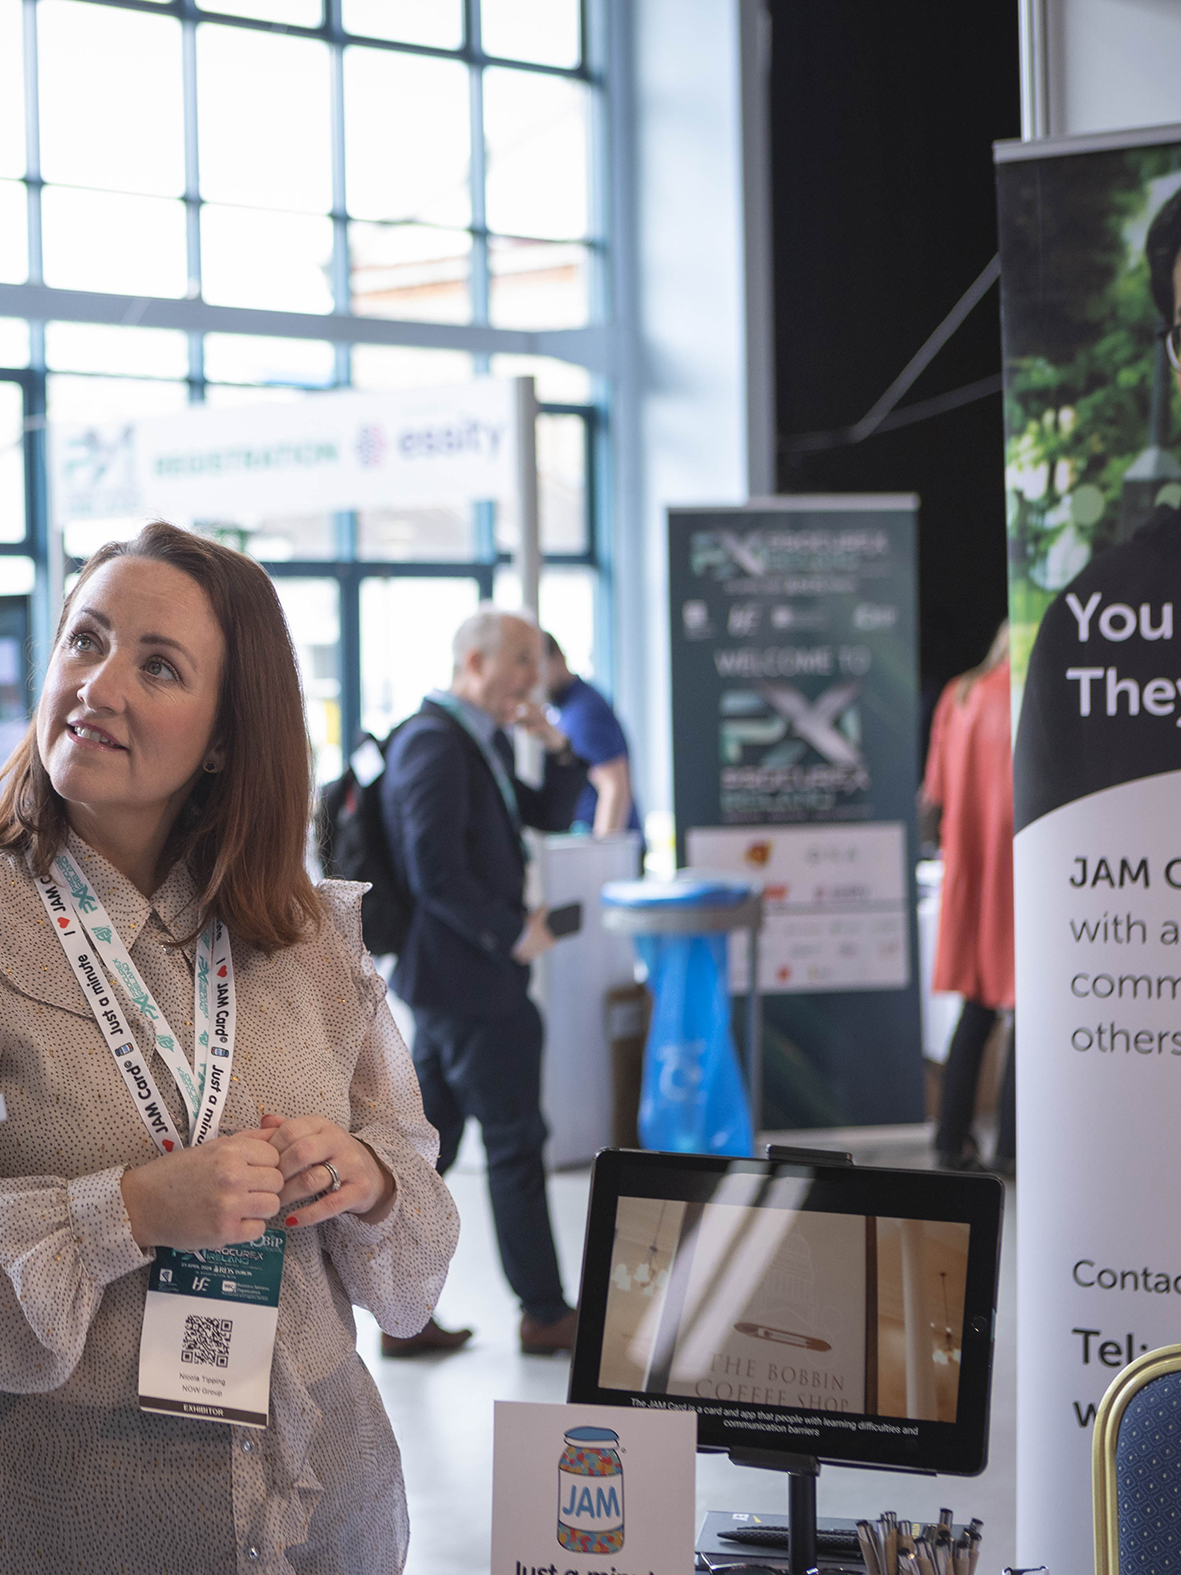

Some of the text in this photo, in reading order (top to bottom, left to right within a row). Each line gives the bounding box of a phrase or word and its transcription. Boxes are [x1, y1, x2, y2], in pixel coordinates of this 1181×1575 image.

[397, 415, 504, 461] essity
[1065, 591, 1173, 642] You
[715, 645, 833, 677] WELCOME
[1065, 665, 1181, 729] The
[1069, 856, 1150, 890] JAM
[45, 886, 66, 912] JAM
[1069, 910, 1147, 944] with
[78, 954, 123, 1035] Just a minute
[217, 983, 229, 1008] JAM
[210, 1064, 224, 1093] Just
[208, 1095, 218, 1105] a
[145, 1102, 169, 1133] JAM
[195, 1108, 214, 1147] minu
[207, 1247, 264, 1260] ROCUREX
[201, 1375, 226, 1387] Tipping
[711, 1353, 845, 1391] THE BOBBIN
[182, 1384, 200, 1393] NOW
[694, 1379, 849, 1413] COFFEE SHOP
[183, 1403, 224, 1417] EXHIBITOR
[703, 1405, 723, 1415] card
[723, 1407, 739, 1418] and
[740, 1410, 756, 1420] app
[757, 1410, 774, 1420] that
[775, 1412, 803, 1425] people
[804, 1415, 822, 1426] with
[823, 1417, 856, 1431] learning
[857, 1421, 901, 1434] difficulties
[902, 1426, 919, 1436] and
[723, 1418, 820, 1437] communication barriers
[562, 1484, 621, 1518] JAM
